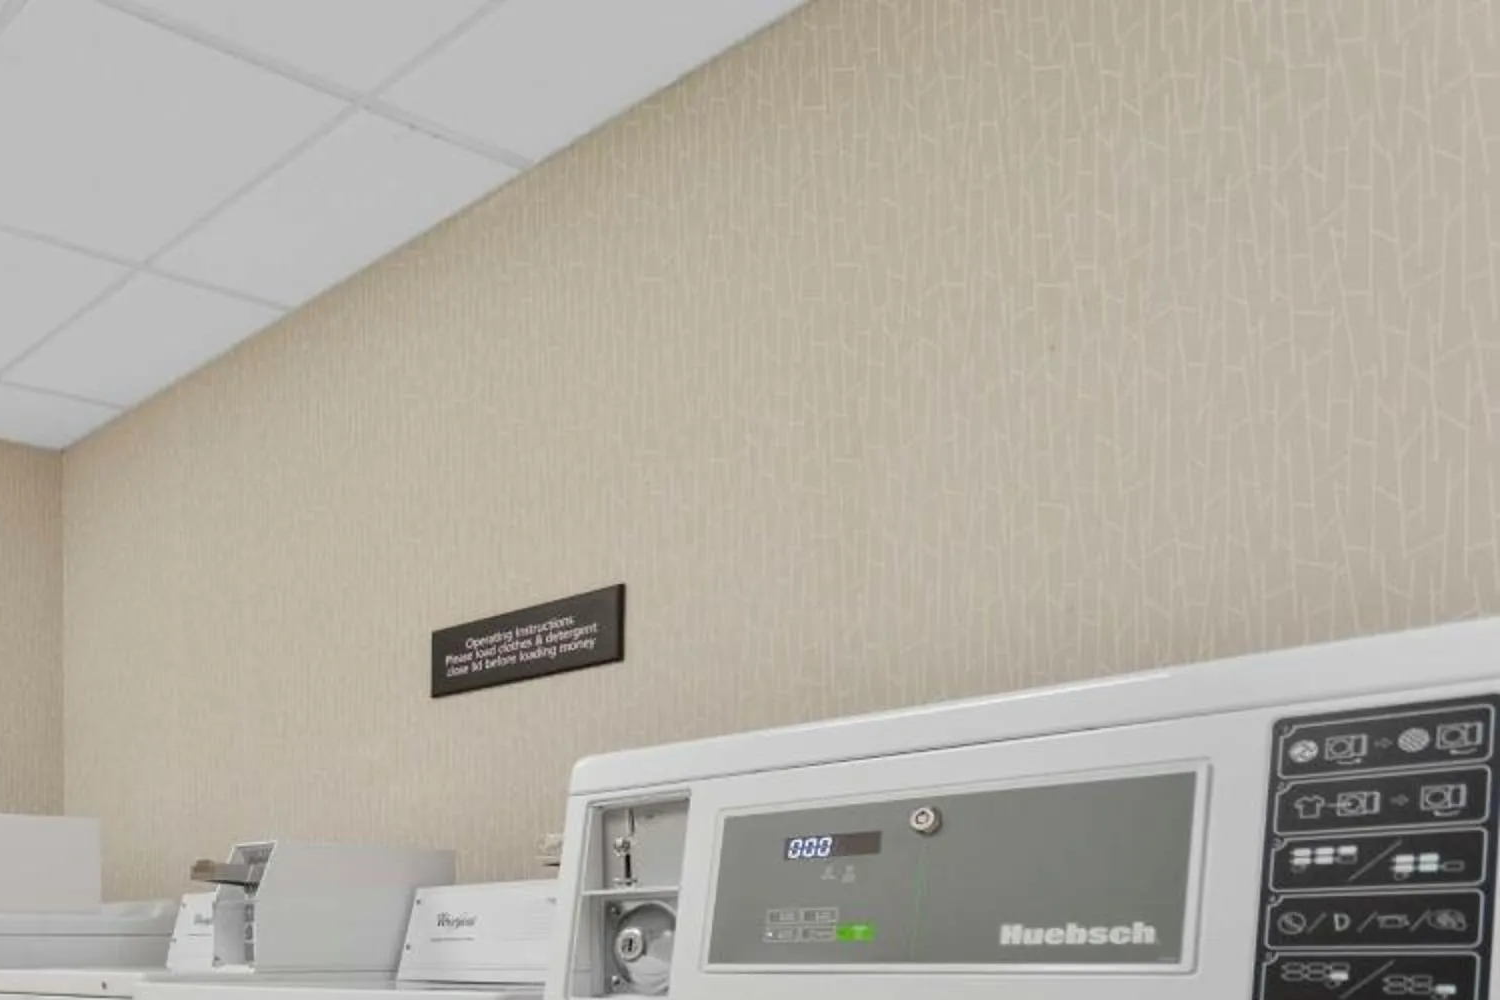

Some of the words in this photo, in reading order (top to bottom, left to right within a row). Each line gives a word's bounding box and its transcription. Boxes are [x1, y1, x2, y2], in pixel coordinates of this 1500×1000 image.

[445, 651, 473, 667] Please
[475, 645, 497, 659] load
[498, 636, 533, 653] clothes
[545, 622, 597, 644] detergent
[465, 631, 513, 651] Operating
[485, 654, 517, 669] before
[519, 645, 557, 663] loading
[999, 921, 1156, 946] Huebsch
